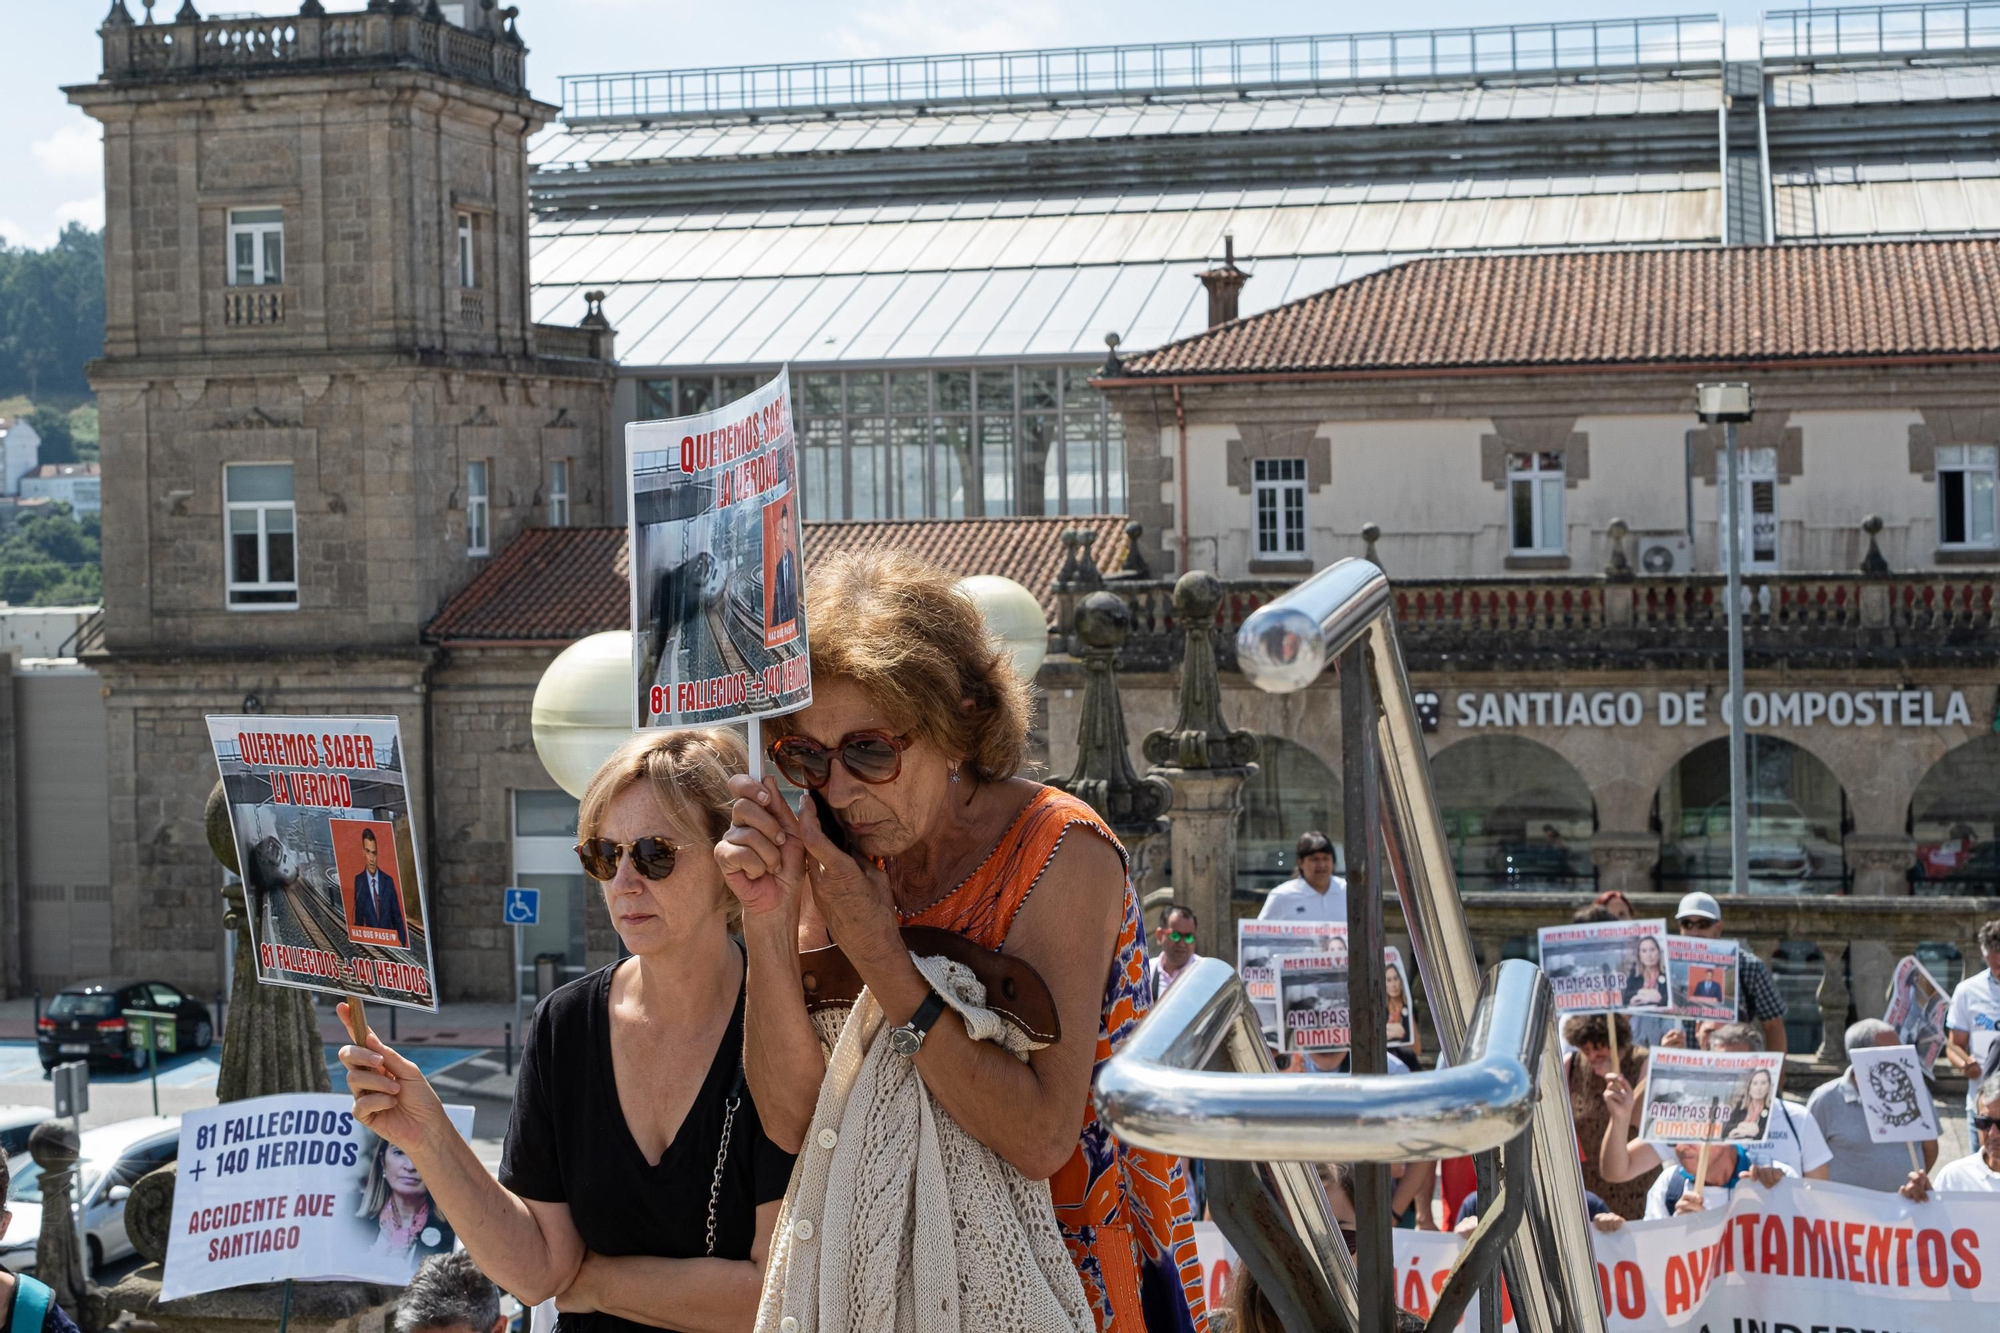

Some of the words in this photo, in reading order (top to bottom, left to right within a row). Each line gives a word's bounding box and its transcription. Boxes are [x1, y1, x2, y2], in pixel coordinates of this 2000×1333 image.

[680, 411, 759, 475] QUEREMOS
[716, 468, 731, 510] LA
[735, 447, 778, 503] VERDAD
[651, 684, 671, 715] 81
[677, 672, 747, 711] FALLECIDOS
[1457, 692, 1643, 727] SANTIAGO
[1658, 691, 1707, 726] DE
[238, 732, 319, 768] QUEREMOS
[322, 734, 377, 769] SABER
[270, 771, 291, 805] LA
[290, 772, 352, 808] VERDAD
[352, 929, 362, 938] HAZ
[362, 930, 374, 940] QUE
[261, 943, 273, 970] 81
[276, 944, 340, 981] FALLECIDOS
[376, 959, 428, 995] HERIDOS
[1284, 957, 1332, 969] MENTIRAS
[1335, 957, 1342, 967] Y
[1576, 974, 1626, 990] PASTOR
[1288, 1012, 1314, 1026] ANA
[1321, 1010, 1347, 1025] PAS
[1296, 1028, 1351, 1046] DIMISI
[1656, 1054, 1703, 1066] MENTIRAS
[1706, 1058, 1712, 1066] Y
[1715, 1058, 1775, 1068] OCULTACIONES
[1650, 1102, 1677, 1118] ANA
[1682, 1106, 1730, 1120] PASTOR
[196, 1124, 216, 1151] 81
[223, 1110, 354, 1145] FALLECIDOS
[189, 1160, 206, 1182] +
[216, 1148, 248, 1177] 140
[256, 1140, 359, 1170] HERIDOS
[189, 1195, 288, 1235] ACCIDENTE
[294, 1194, 335, 1218] AVE
[208, 1225, 300, 1263] SANTIAGO
[1666, 1213, 1982, 1316] AYNTAMIENTOS
